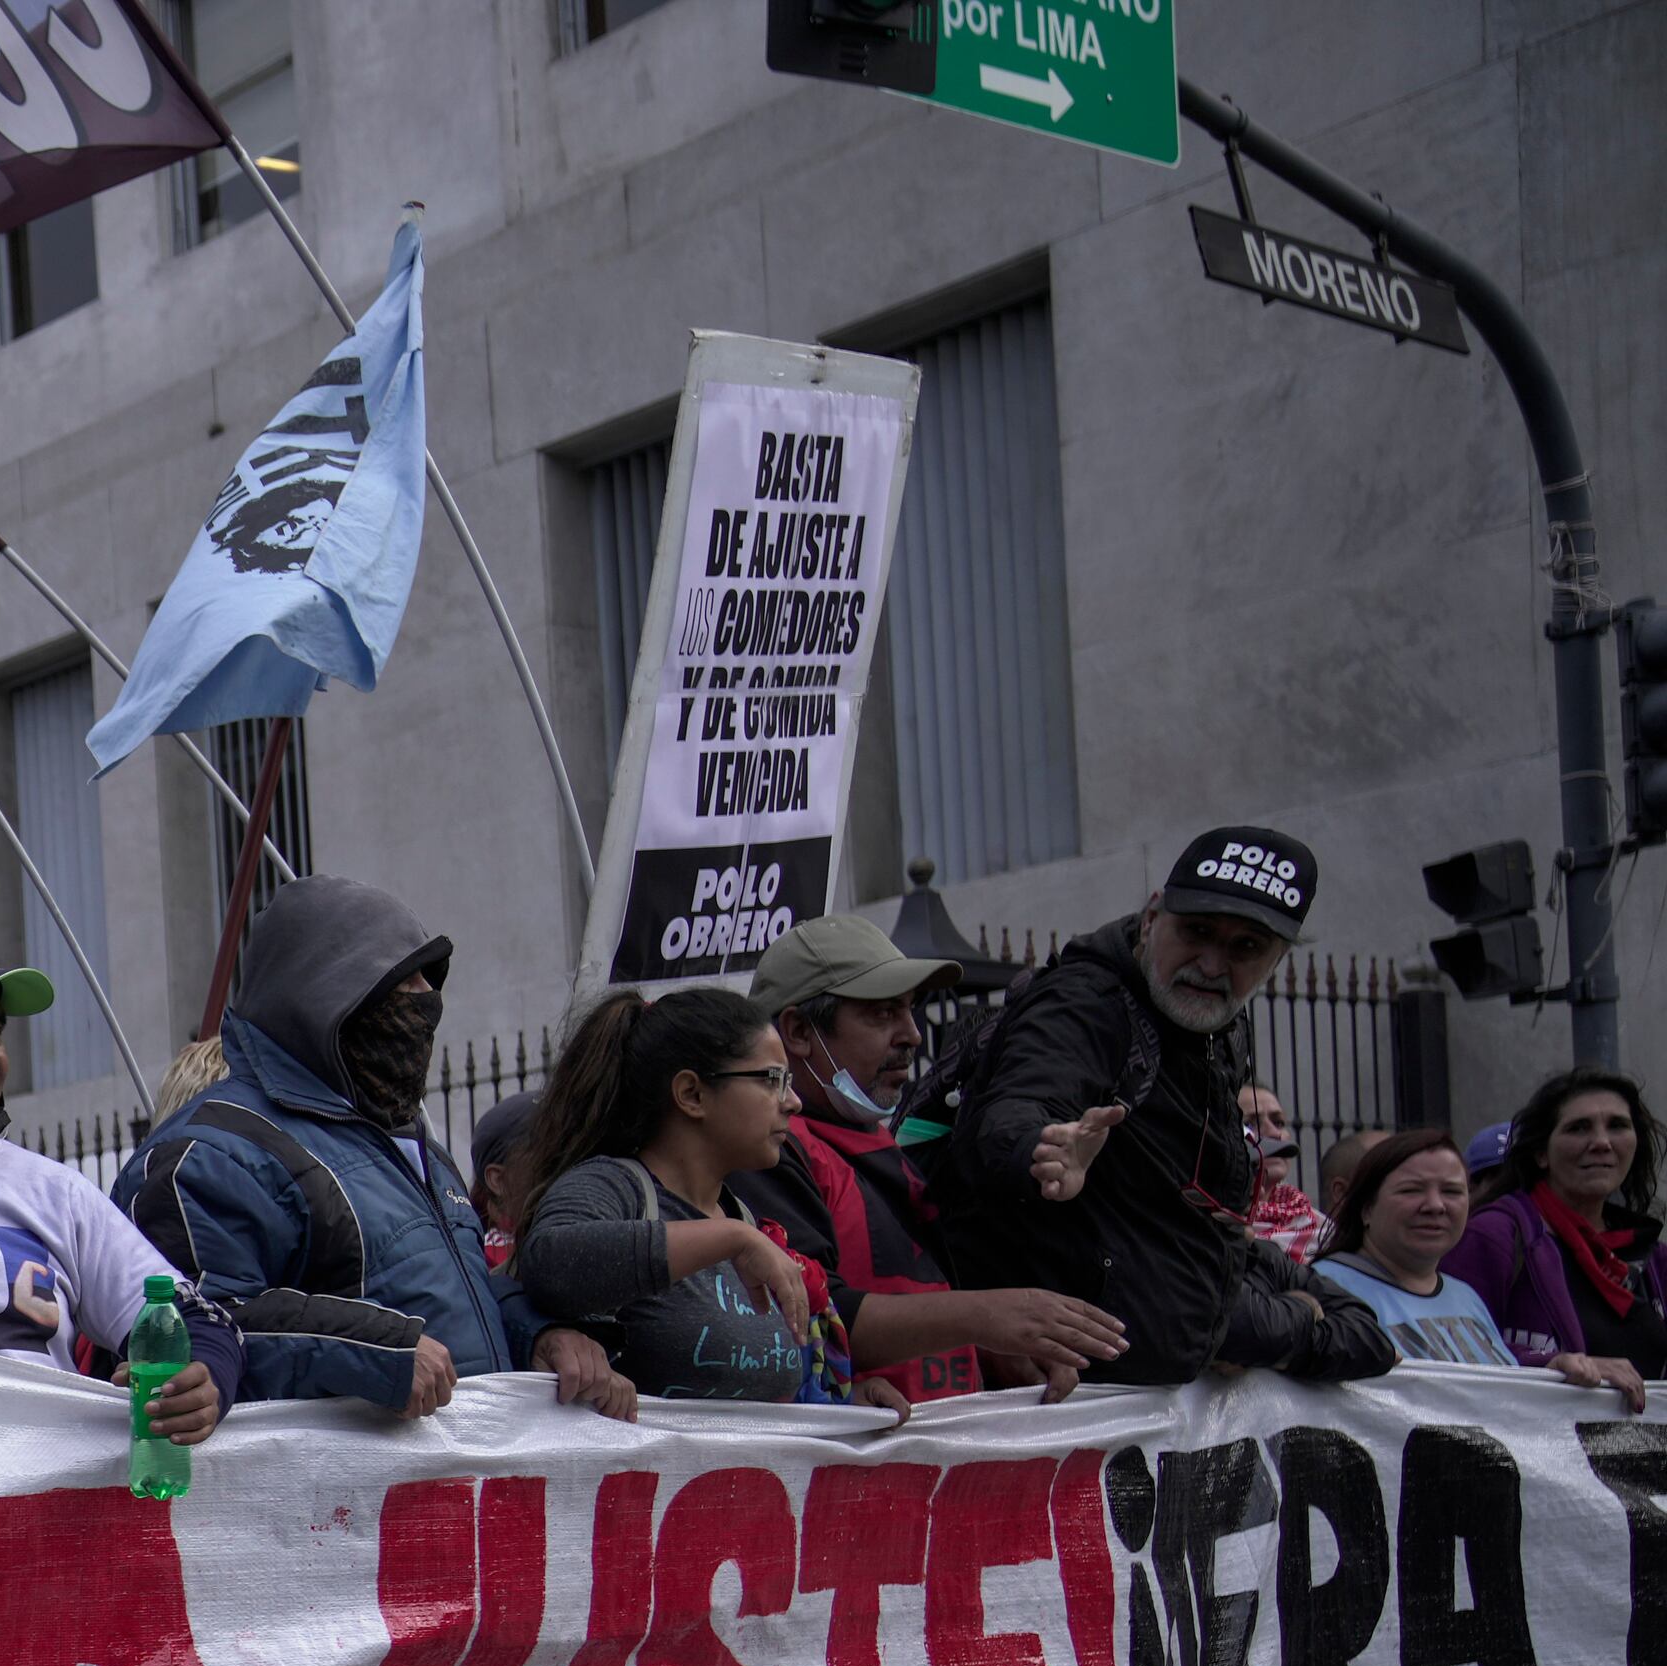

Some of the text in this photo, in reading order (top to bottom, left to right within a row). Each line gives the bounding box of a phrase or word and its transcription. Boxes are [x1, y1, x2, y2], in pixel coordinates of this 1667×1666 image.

[942, 0, 1003, 39] por
[1015, 0, 1106, 70] LIMA
[1242, 228, 1420, 333] MORENO
[755, 431, 844, 504] BASTA
[705, 508, 866, 581] DE AJUSTE A
[679, 588, 865, 657] LOS COMEDORES
[676, 664, 841, 742] Y DE COMIDA
[695, 748, 809, 817] VENCIDA
[690, 863, 781, 912] POLO
[1197, 860, 1300, 908] OBRERO
[1222, 842, 1295, 880] POLO
[660, 904, 792, 960] OBRERO
[922, 1356, 971, 1391] DE
